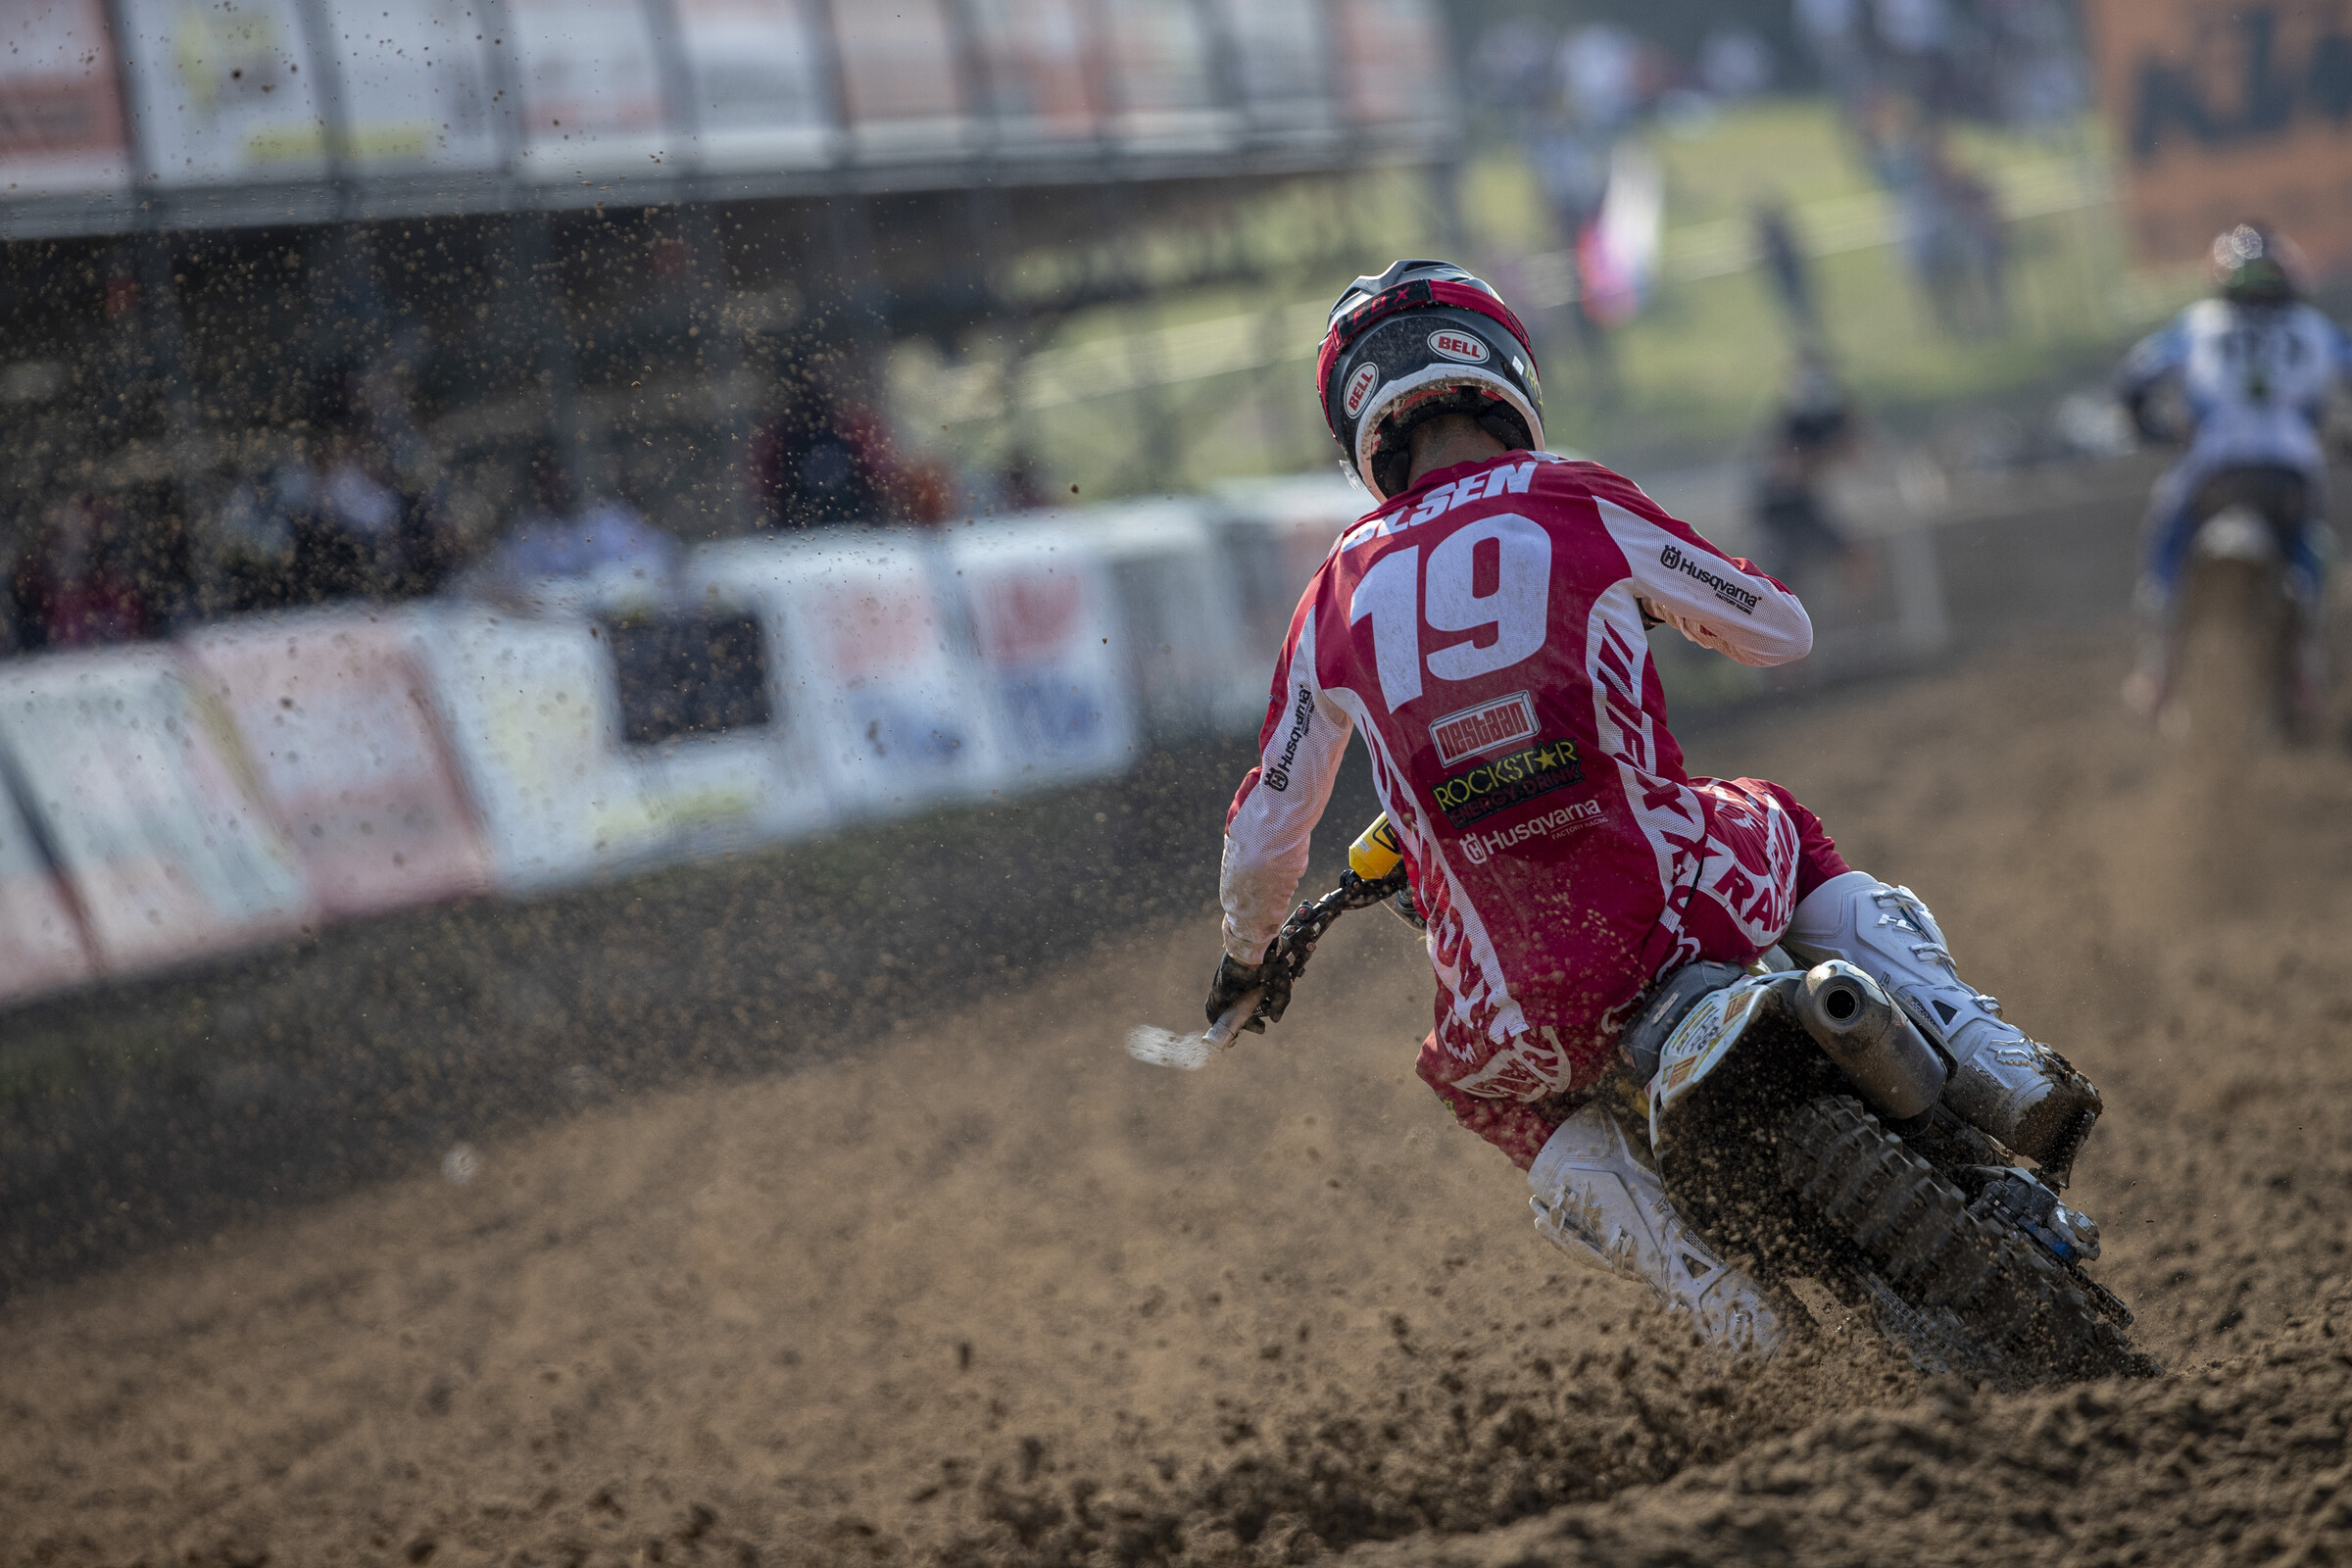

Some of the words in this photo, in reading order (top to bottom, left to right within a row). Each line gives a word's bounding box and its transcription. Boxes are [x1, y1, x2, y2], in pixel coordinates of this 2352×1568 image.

[1352, 286, 1410, 325] FOX
[1438, 336, 1481, 359] BELL
[1348, 372, 1374, 412] BELL
[1680, 558, 1758, 608] Husqvarna
[1349, 513, 1552, 714] 19
[1450, 787, 1516, 824] ENERGY
[1523, 765, 1580, 795] DRINK
[1482, 800, 1600, 855] Husqvarna
[1551, 823, 1584, 841] FACTORY
